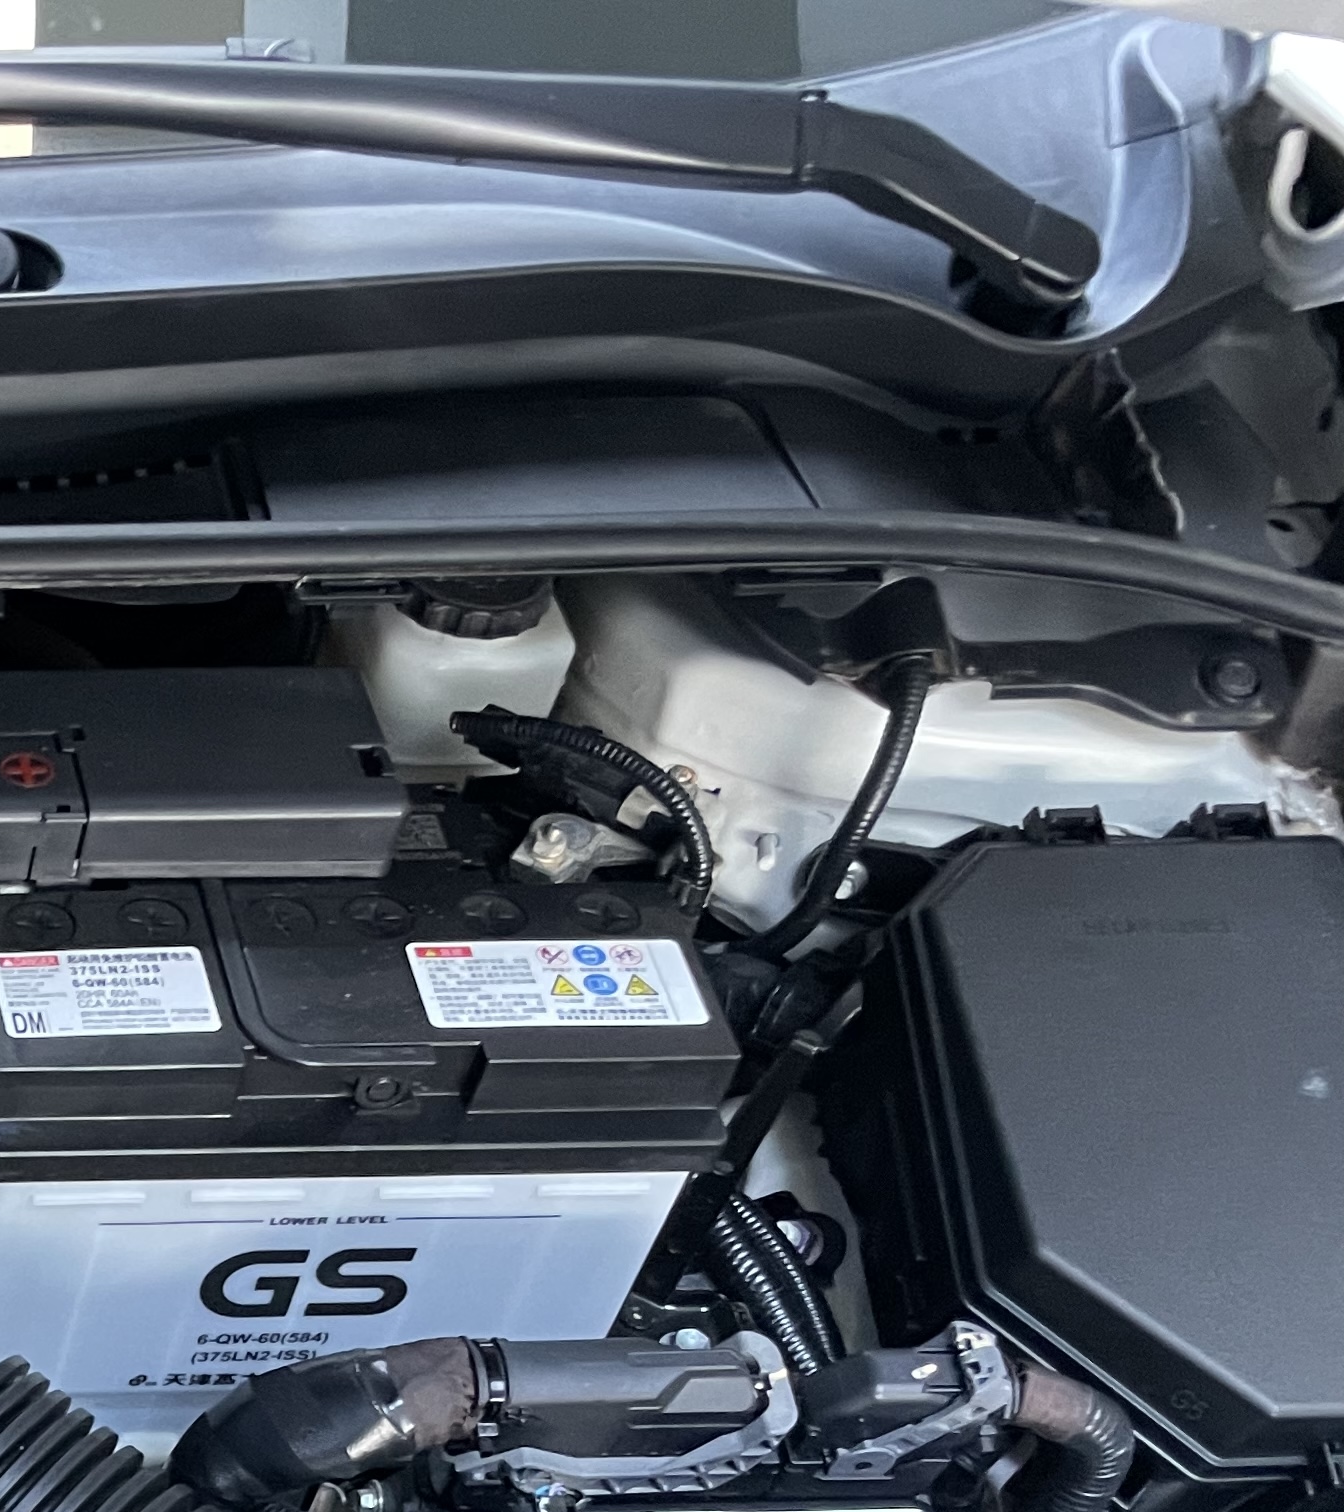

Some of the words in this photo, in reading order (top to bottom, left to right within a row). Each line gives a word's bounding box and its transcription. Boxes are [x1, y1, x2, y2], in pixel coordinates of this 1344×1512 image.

[69, 965, 161, 976] 375LN2-ISS
[71, 976, 165, 988] 6-QW-60(584)
[12, 1011, 47, 1035] DM
[269, 1216, 328, 1226] LOWER
[336, 1215, 389, 1225] LEVEL
[199, 1247, 418, 1318] GS
[197, 1331, 330, 1345] 6-QW-60(584)
[191, 1350, 317, 1364] (375LN2-ISS)
